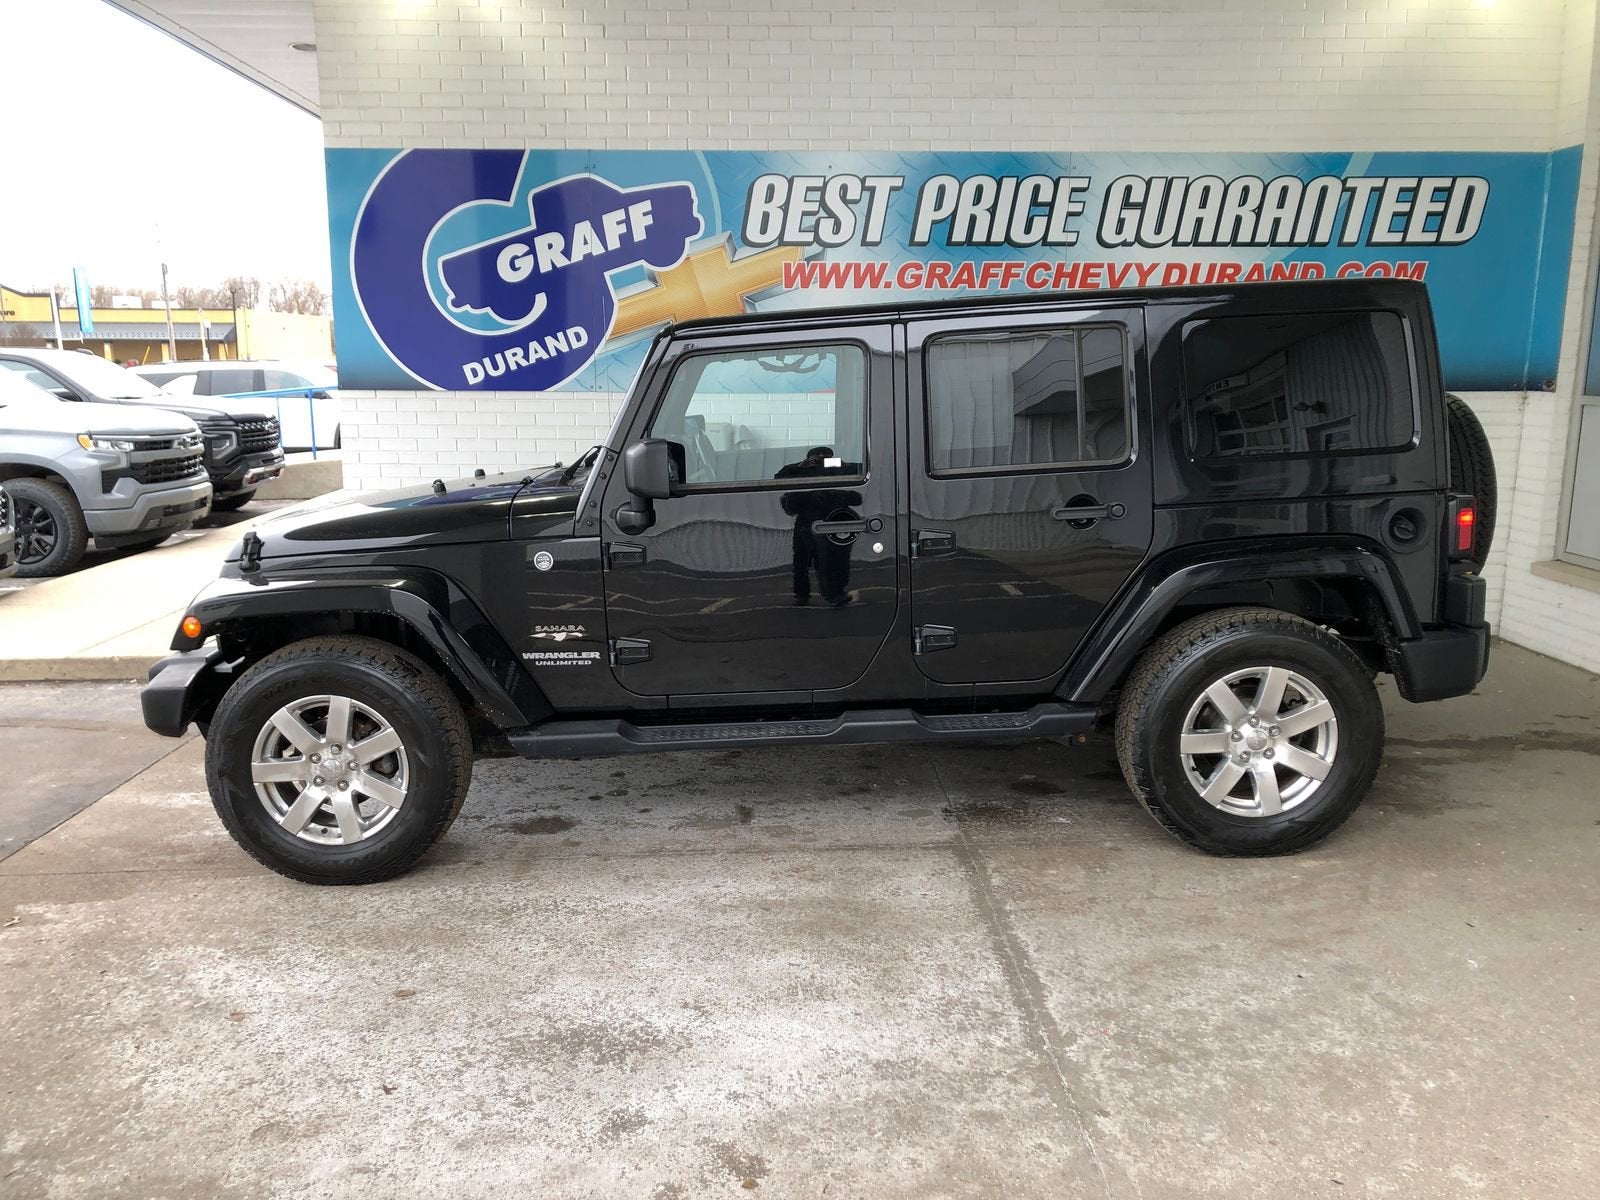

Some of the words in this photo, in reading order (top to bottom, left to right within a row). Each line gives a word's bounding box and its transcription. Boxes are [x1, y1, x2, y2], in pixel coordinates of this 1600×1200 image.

[497, 199, 654, 283] GRAFF
[741, 173, 905, 248] BEST
[909, 173, 1092, 248] PRICE
[1096, 174, 1490, 248] GUARANTEED
[782, 261, 1429, 290] WWW.GRAFFCHEVYDURANDCOM
[462, 325, 589, 385] DURAND
